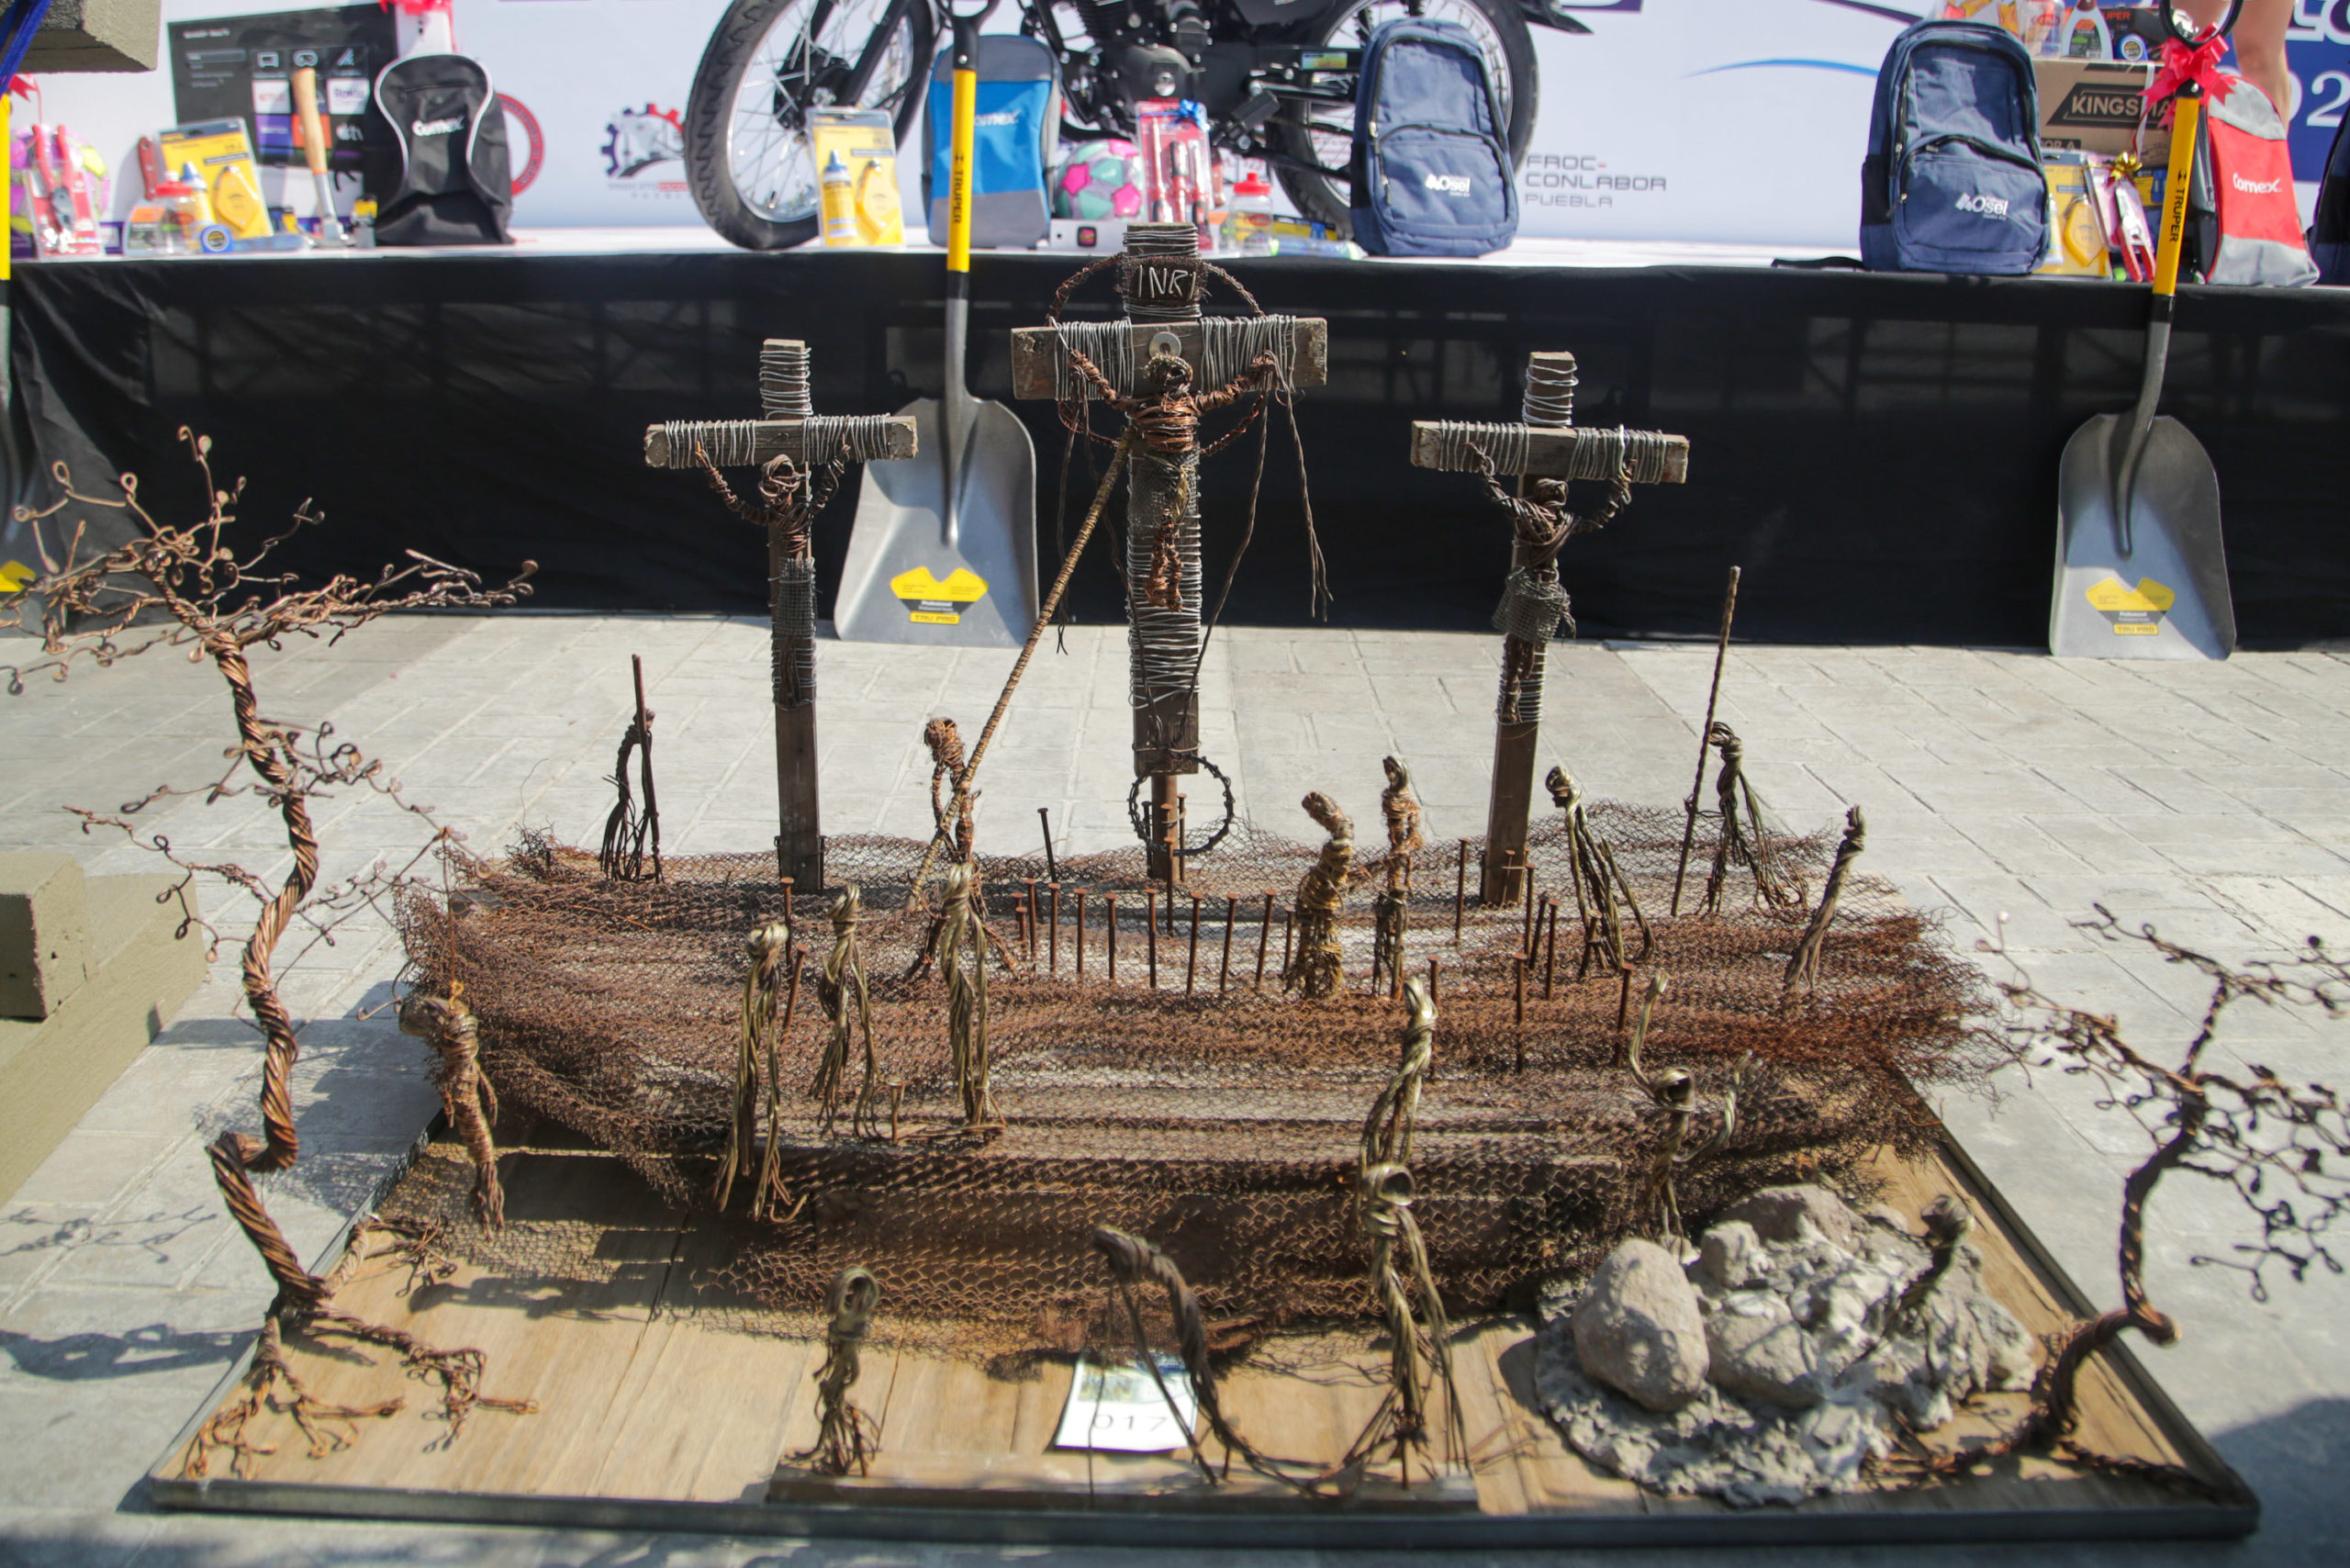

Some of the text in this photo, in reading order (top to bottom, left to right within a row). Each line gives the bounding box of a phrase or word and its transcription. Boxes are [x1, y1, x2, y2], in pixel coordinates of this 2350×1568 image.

[975, 109, 1021, 127] omex
[1440, 174, 1471, 192] Osel
[1526, 174, 1667, 191] CONLABOR
[2232, 173, 2280, 194] Comex
[954, 171, 963, 224] TRUPER
[1525, 194, 1613, 208] PUEBLA
[1972, 195, 2009, 216] Osel
[2169, 187, 2186, 242] TRUPER
[1138, 265, 1196, 299] INRI
